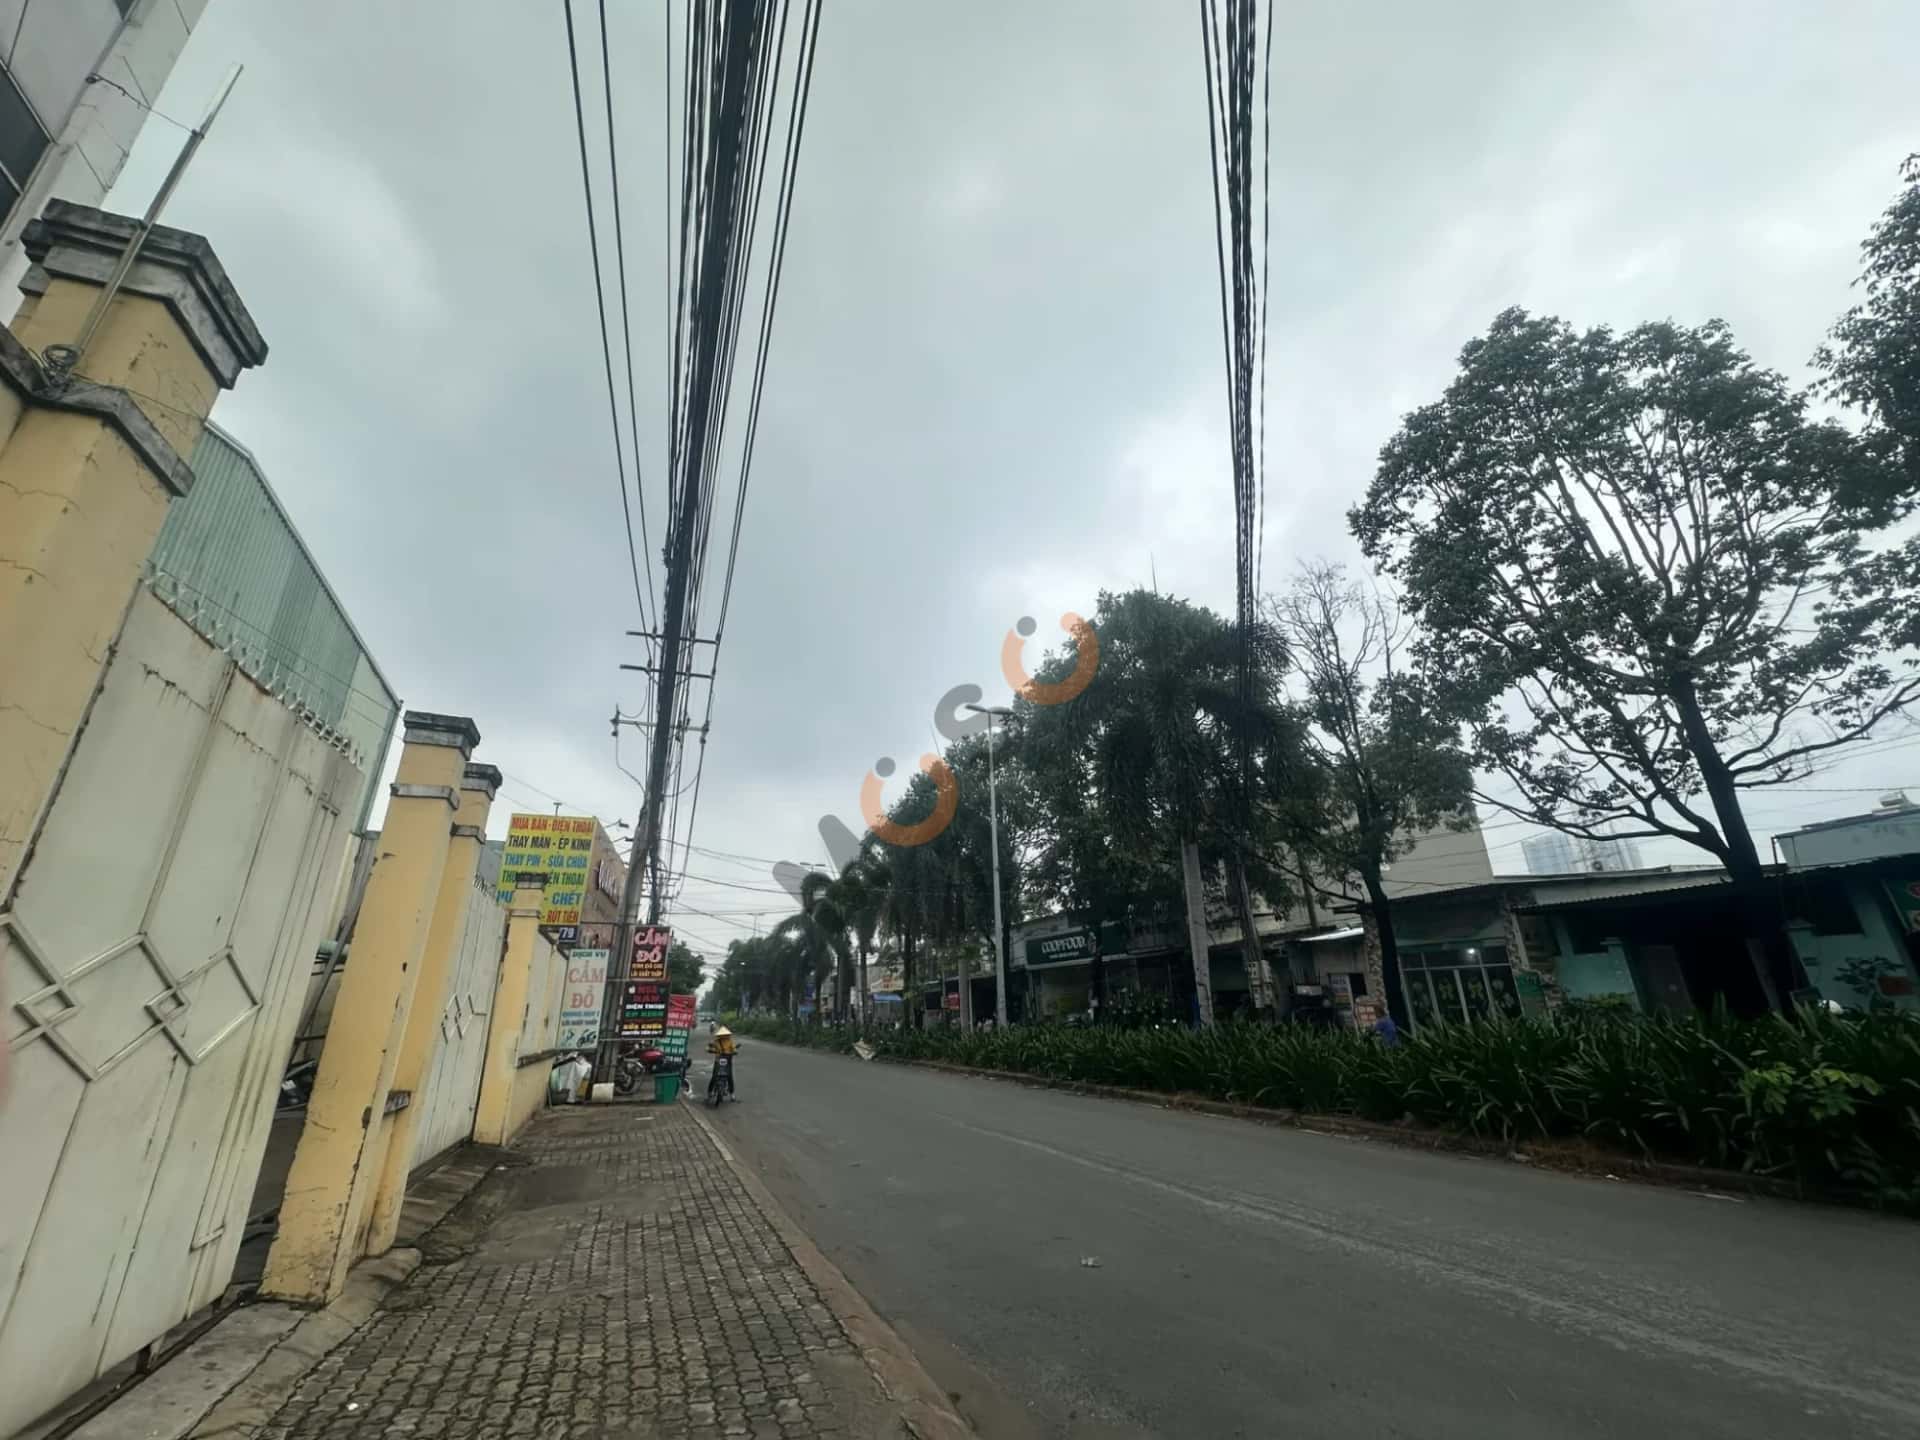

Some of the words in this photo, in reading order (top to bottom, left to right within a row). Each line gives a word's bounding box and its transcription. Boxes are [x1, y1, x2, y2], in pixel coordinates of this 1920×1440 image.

[512, 816, 529, 830] MUA
[509, 834, 530, 849] THAY
[505, 853, 525, 867] THAY
